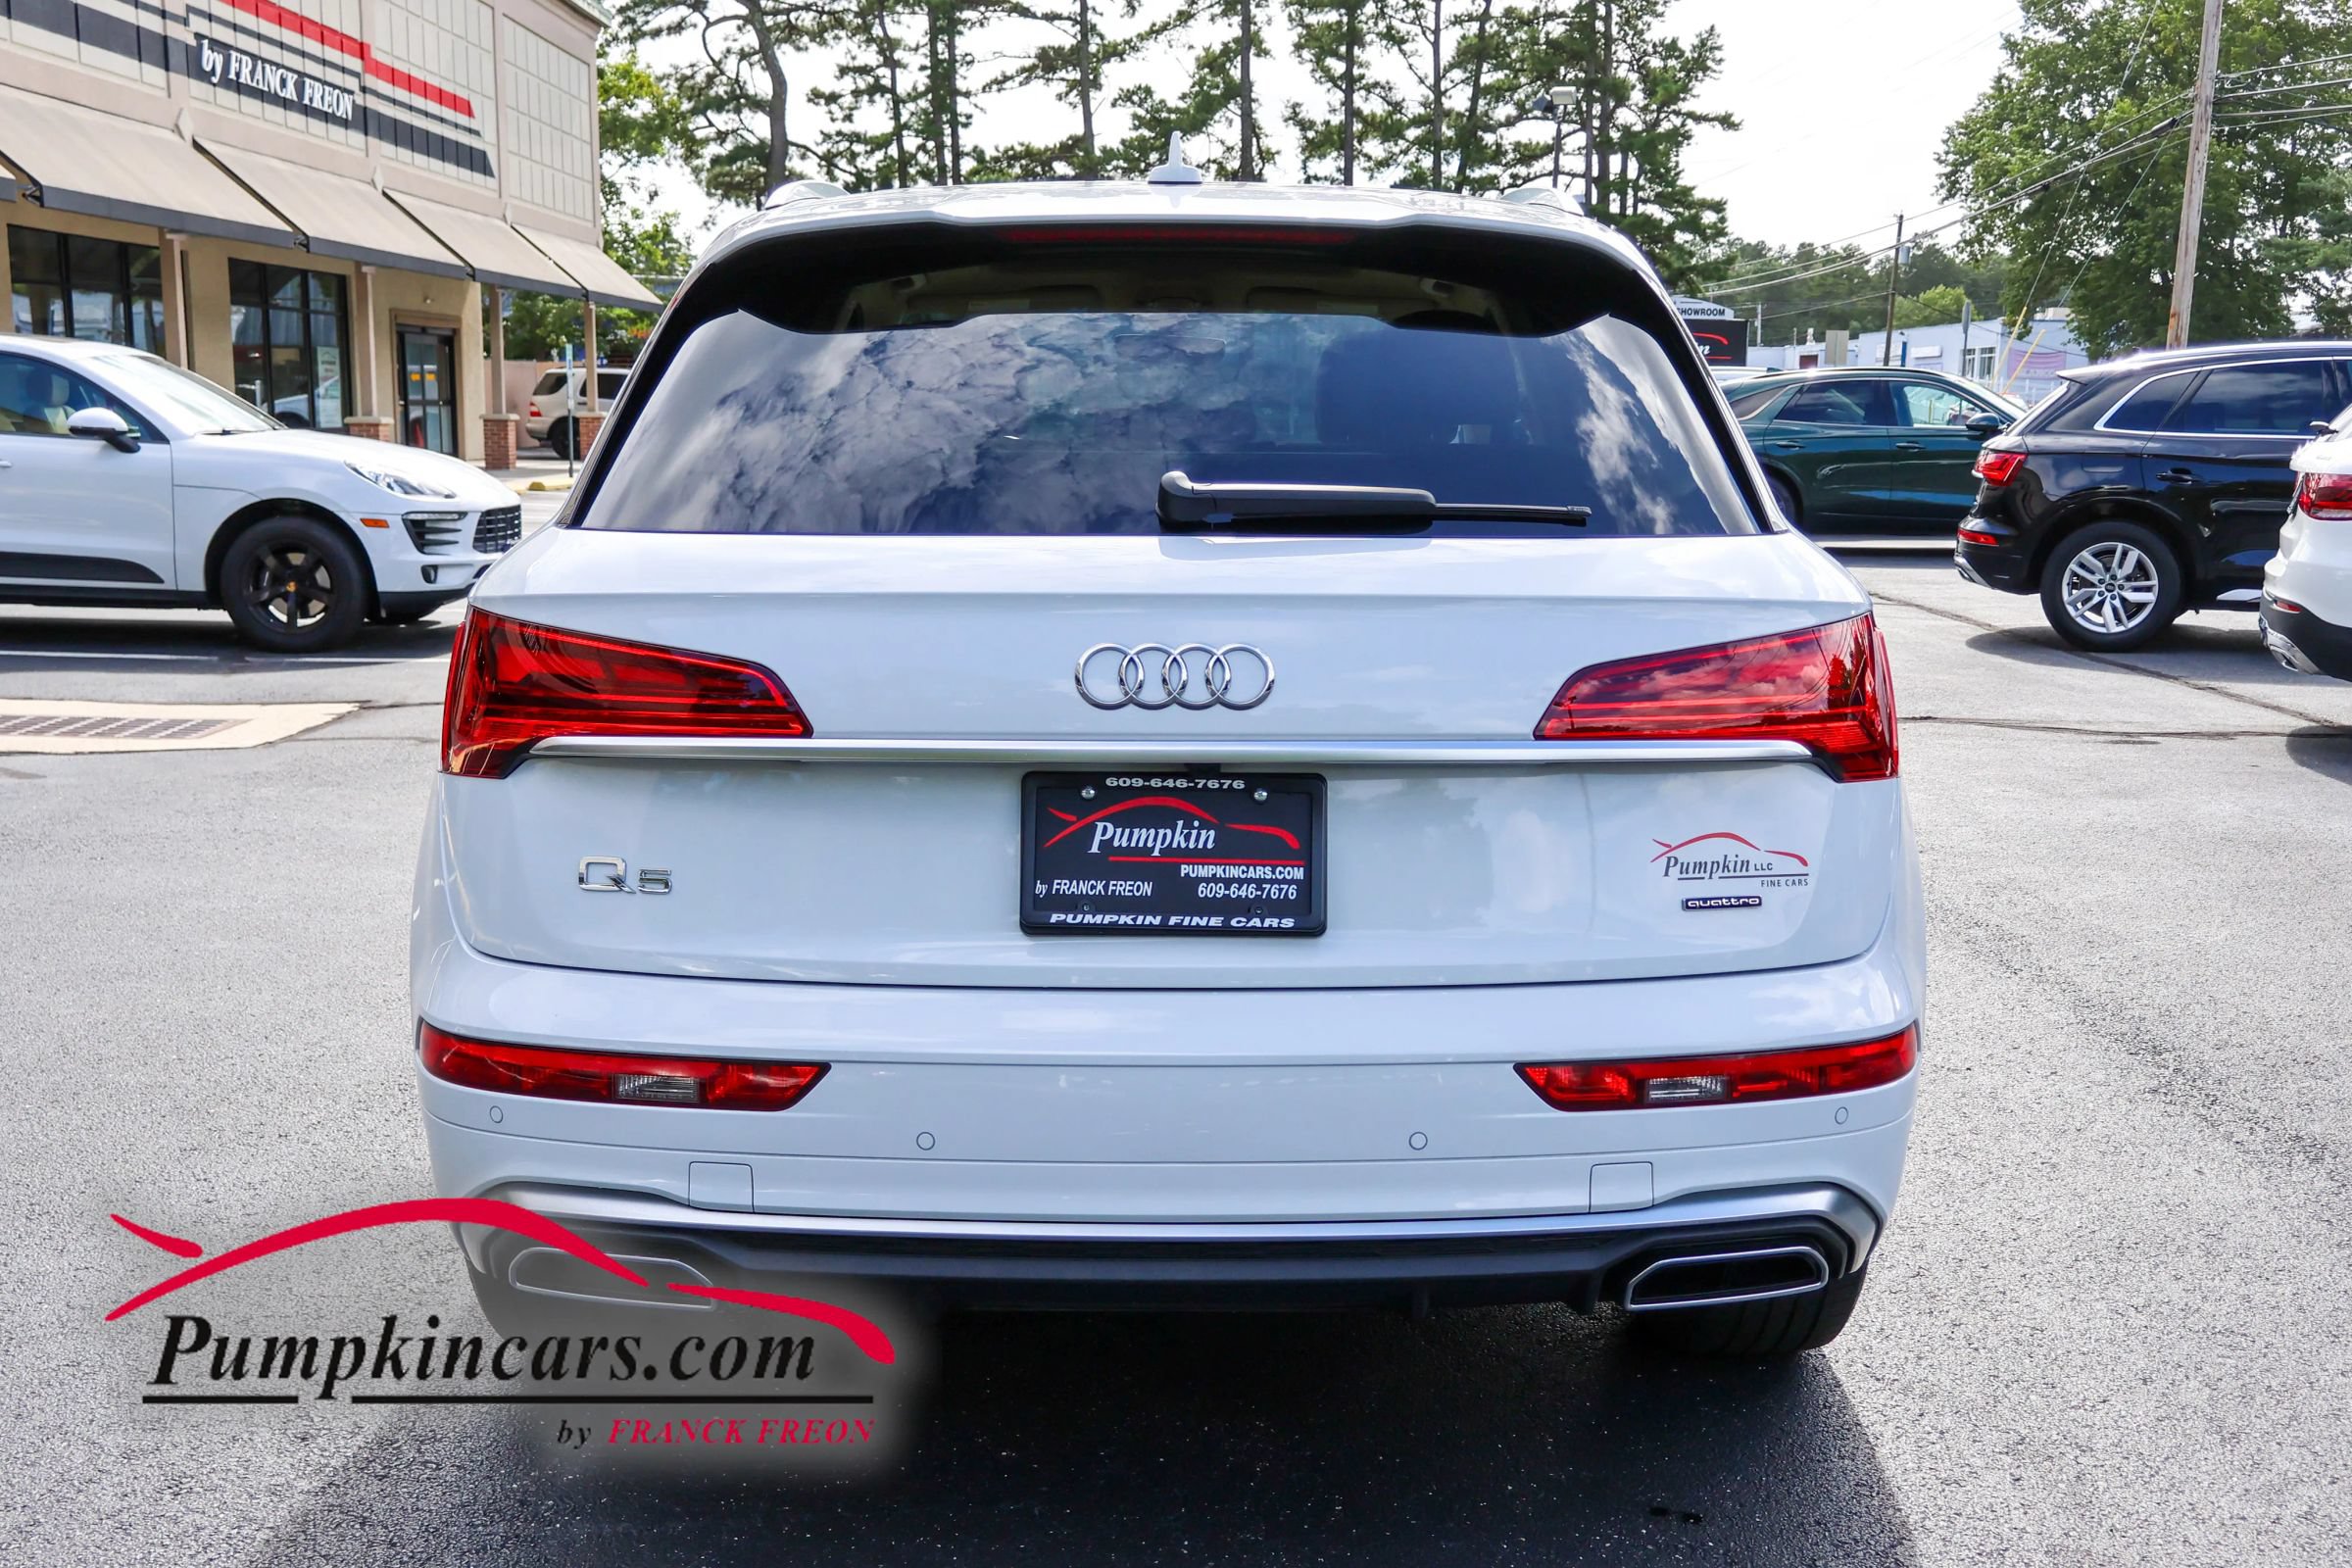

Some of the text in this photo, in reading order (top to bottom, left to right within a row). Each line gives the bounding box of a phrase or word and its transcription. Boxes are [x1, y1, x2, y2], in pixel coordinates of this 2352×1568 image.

[201, 39, 354, 122] by FRANCK FREON
[1104, 777, 1246, 790] 609-646-7676
[1088, 820, 1216, 857] Pumpkin
[578, 856, 672, 895] Q5
[1180, 864, 1304, 880] PUMPKINCARS.COM
[1662, 855, 1774, 879] Pumpkin LLC
[1035, 879, 1152, 897] by FRANCK FREON
[1198, 882, 1298, 900] 609-646-7676
[1761, 878, 1809, 888] FINE CARS
[1688, 898, 1760, 907] quattro
[1050, 913, 1295, 928] PUMPKIN FINE CARS
